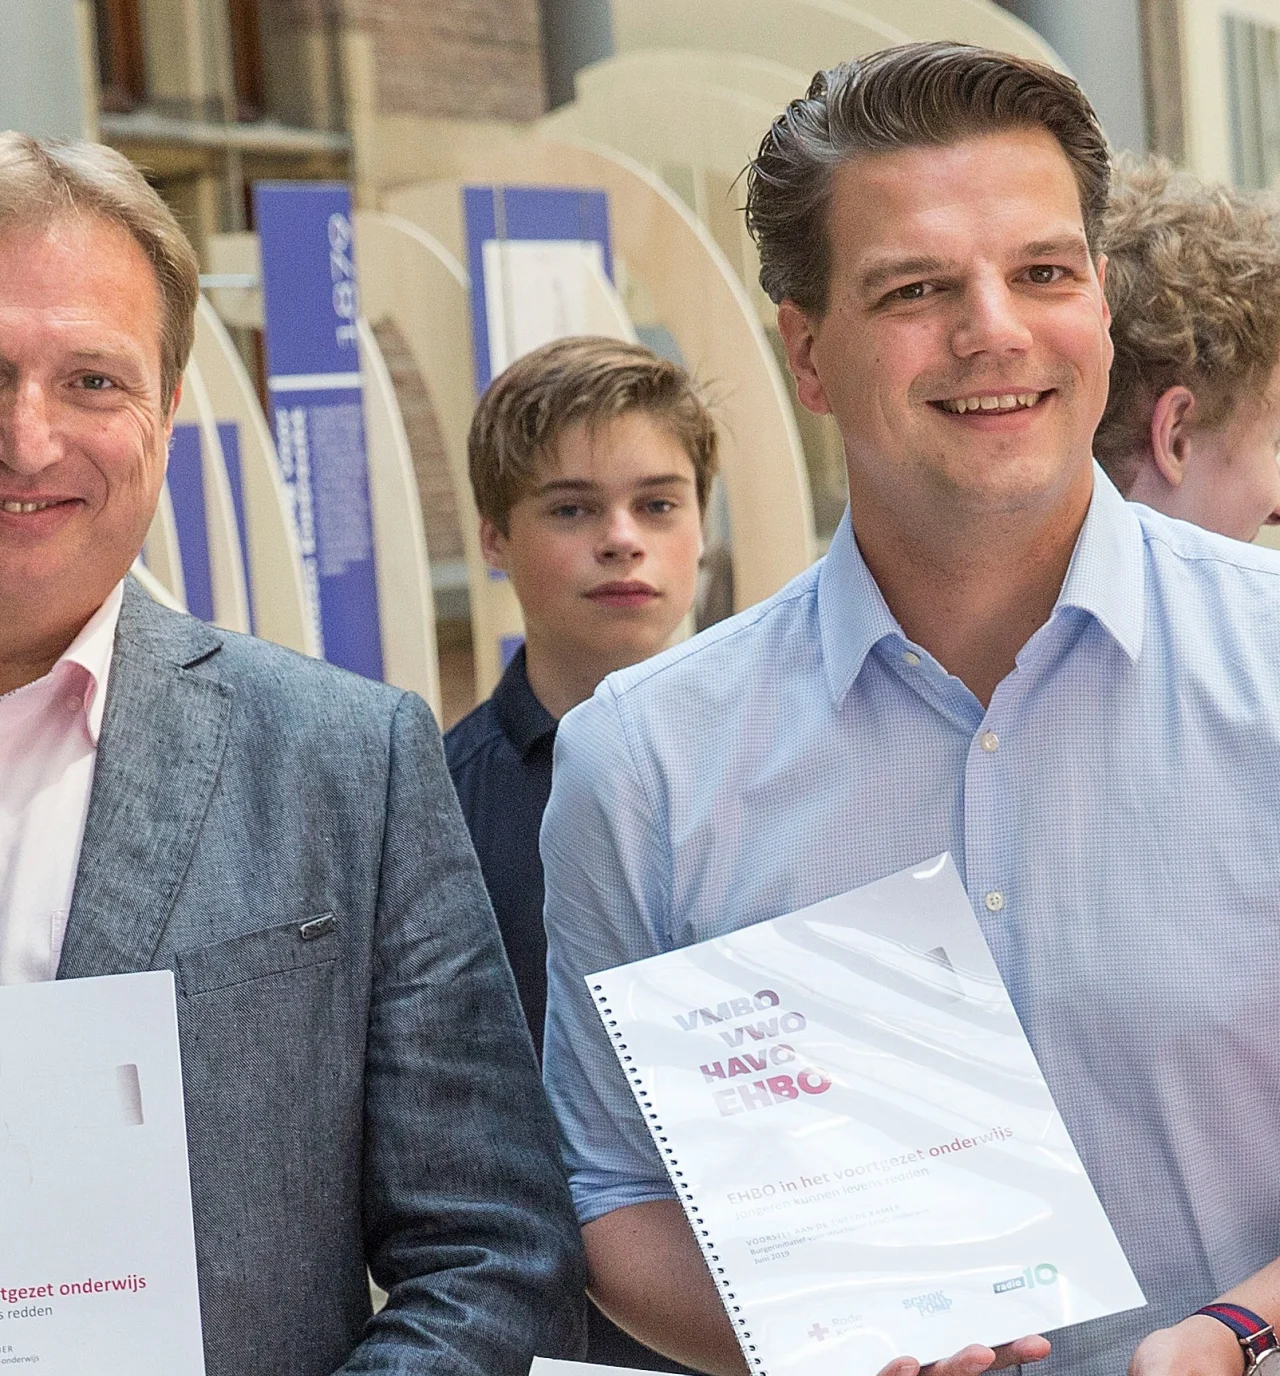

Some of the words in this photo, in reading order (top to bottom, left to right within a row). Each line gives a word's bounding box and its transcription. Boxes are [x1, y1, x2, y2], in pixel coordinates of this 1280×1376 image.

[672, 989, 780, 1031] VMBO
[719, 1012, 807, 1048] VWO
[700, 1044, 796, 1084] HAVO
[712, 1067, 832, 1117] EHBO
[727, 1184, 776, 1205] EHBO
[779, 1180, 798, 1194] in
[800, 1173, 829, 1189] het
[833, 1149, 926, 1180] voortgezet
[928, 1125, 1014, 1157] onderwijs
[59, 1274, 146, 1295] onderwijs
[996, 1279, 1021, 1292] radio
[1023, 1263, 1058, 1289] 10
[8, 1305, 53, 1320] redden
